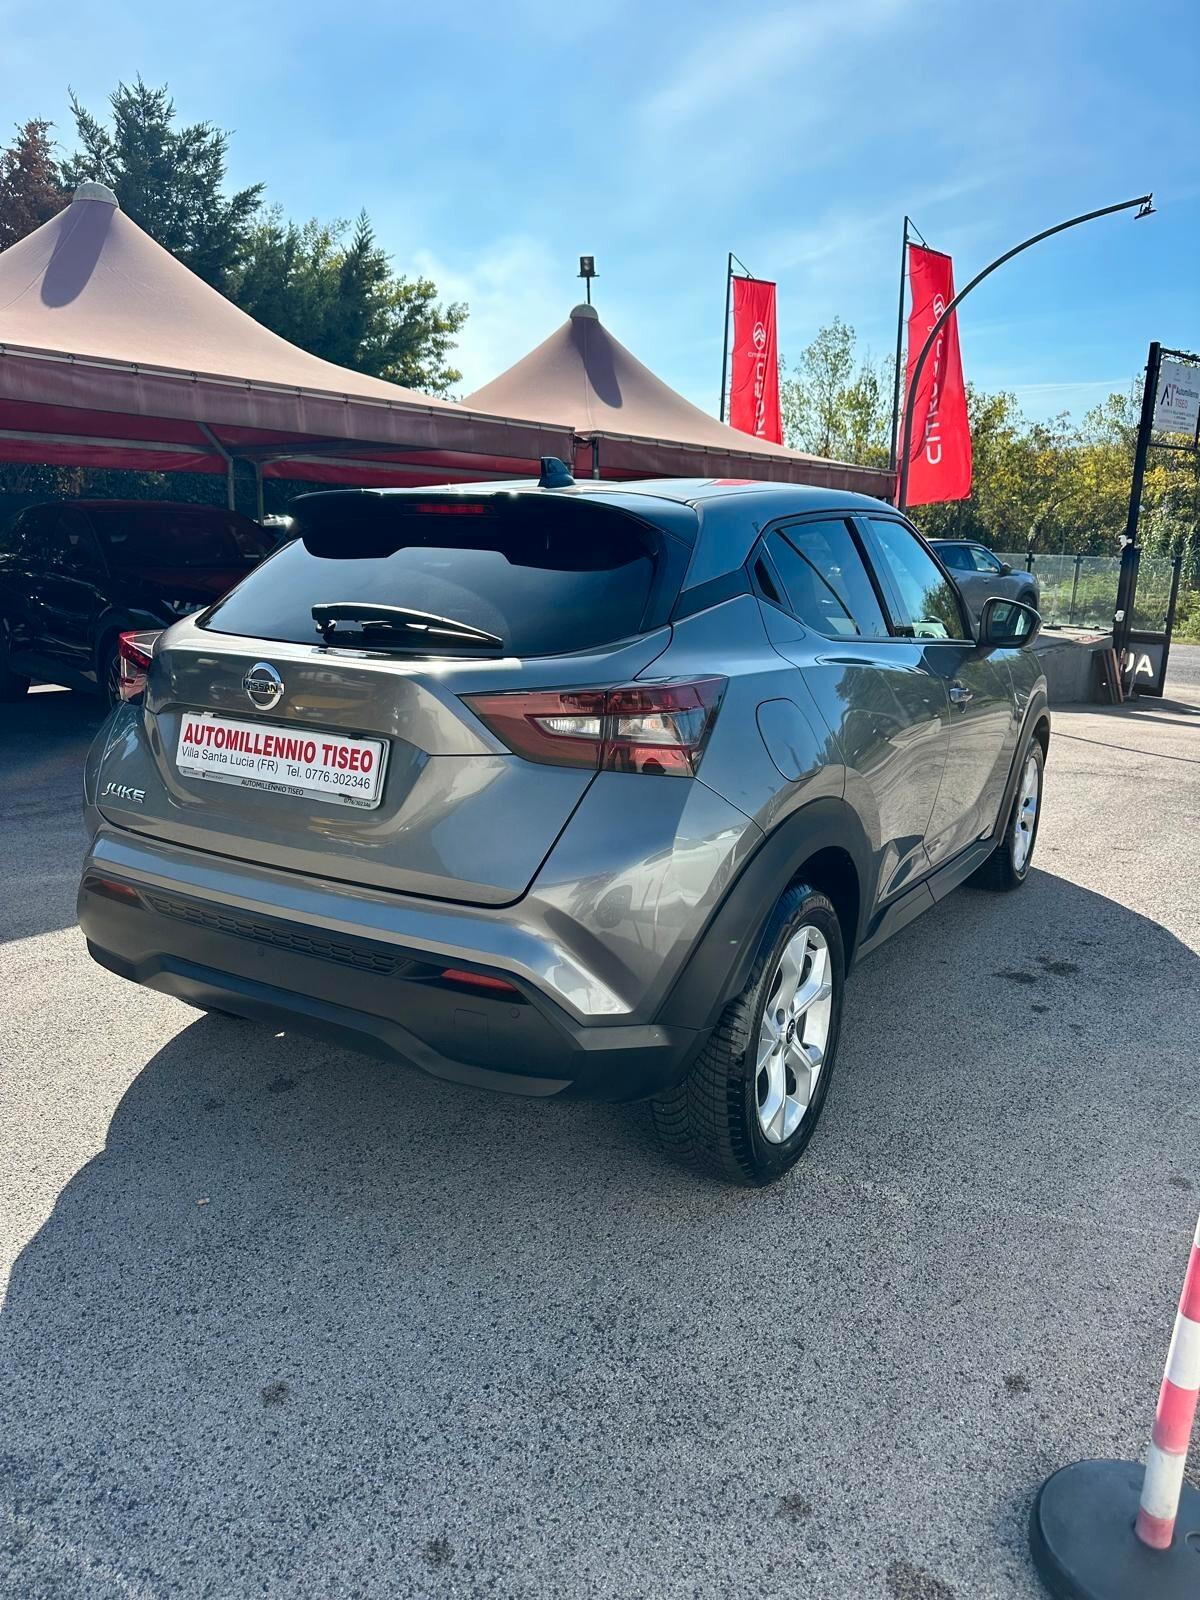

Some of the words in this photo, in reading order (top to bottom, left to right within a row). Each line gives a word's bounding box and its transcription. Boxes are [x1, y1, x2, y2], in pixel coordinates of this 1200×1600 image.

[245, 680, 278, 693] NISSAN
[183, 723, 316, 763] AUTOMILLENNIO
[322, 744, 373, 773] TISEO
[181, 746, 199, 759] Villa
[201, 749, 227, 763] Santa
[230, 754, 254, 768] Lucia
[257, 758, 278, 775] (FR)
[286, 764, 302, 778] Tel.
[305, 768, 370, 790] 0776.302346
[101, 783, 146, 803] JUKE
[241, 779, 286, 792] AUTOMILLENNIO
[287, 787, 303, 795] TISEO
